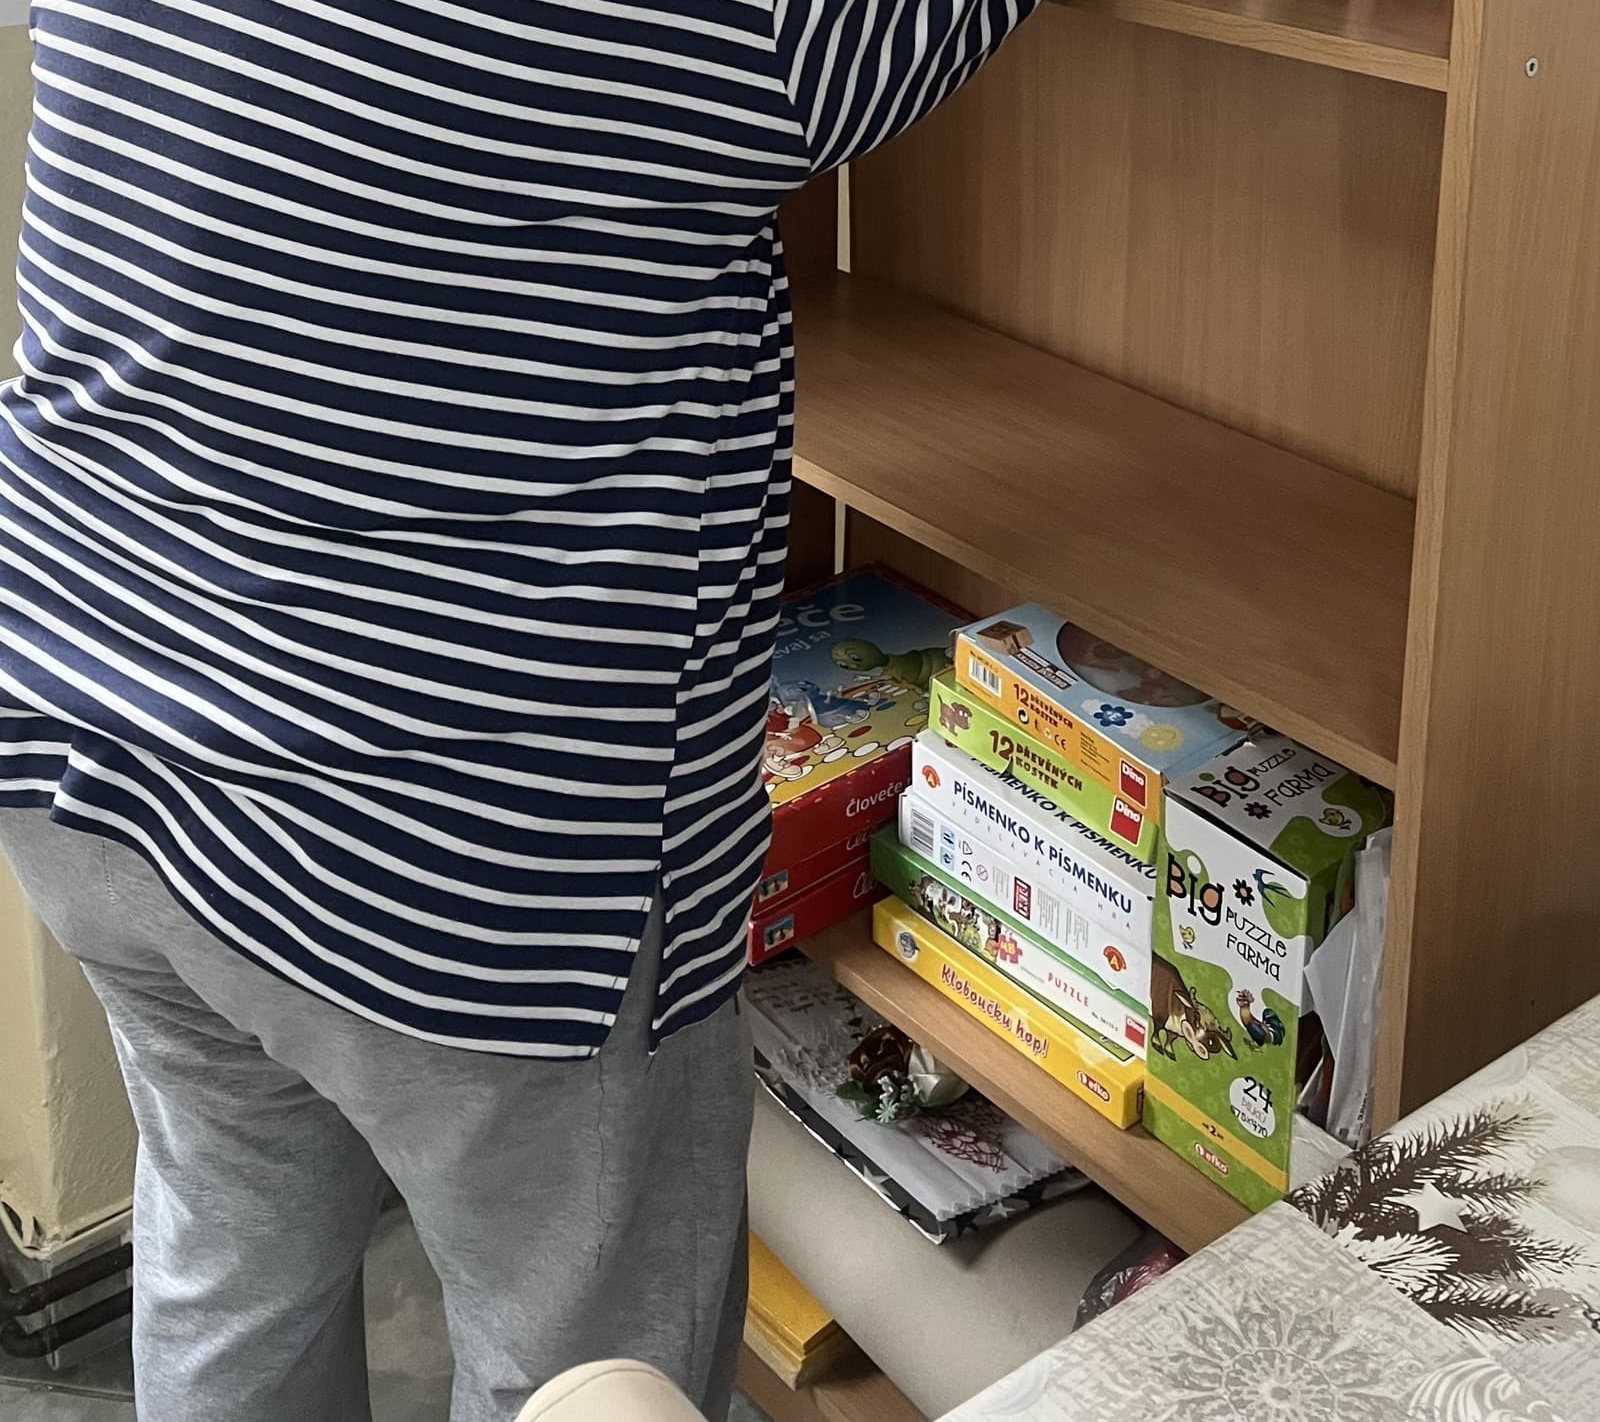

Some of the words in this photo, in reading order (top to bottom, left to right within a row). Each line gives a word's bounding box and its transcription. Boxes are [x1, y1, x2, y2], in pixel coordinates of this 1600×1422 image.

[777, 603, 865, 636] eče
[772, 640, 811, 659] evaj
[808, 630, 832, 643] sa
[1013, 683, 1030, 707] 12
[989, 729, 1015, 760] 12
[1016, 743, 1084, 792] DŘEVĚNÝCH
[1015, 756, 1060, 790] KOSTEK
[1121, 762, 1145, 787] Dino
[845, 781, 904, 818] Človeče
[1115, 799, 1140, 823] Dino
[1054, 810, 1074, 822] K
[954, 780, 1031, 844] PÍSMENKO
[1034, 835, 1046, 856] K
[1048, 845, 1133, 915] PÍSMENKU
[1000, 939, 1017, 957] 48
[1047, 971, 1090, 1007] PUZZLE
[941, 962, 1012, 1035] Kloboučku
[1016, 1017, 1050, 1059] hop!
[1087, 1080, 1110, 1102] efko
[1242, 1075, 1273, 1115] 24
[1208, 1126, 1218, 1136] 2
[1205, 1152, 1228, 1174] efko
